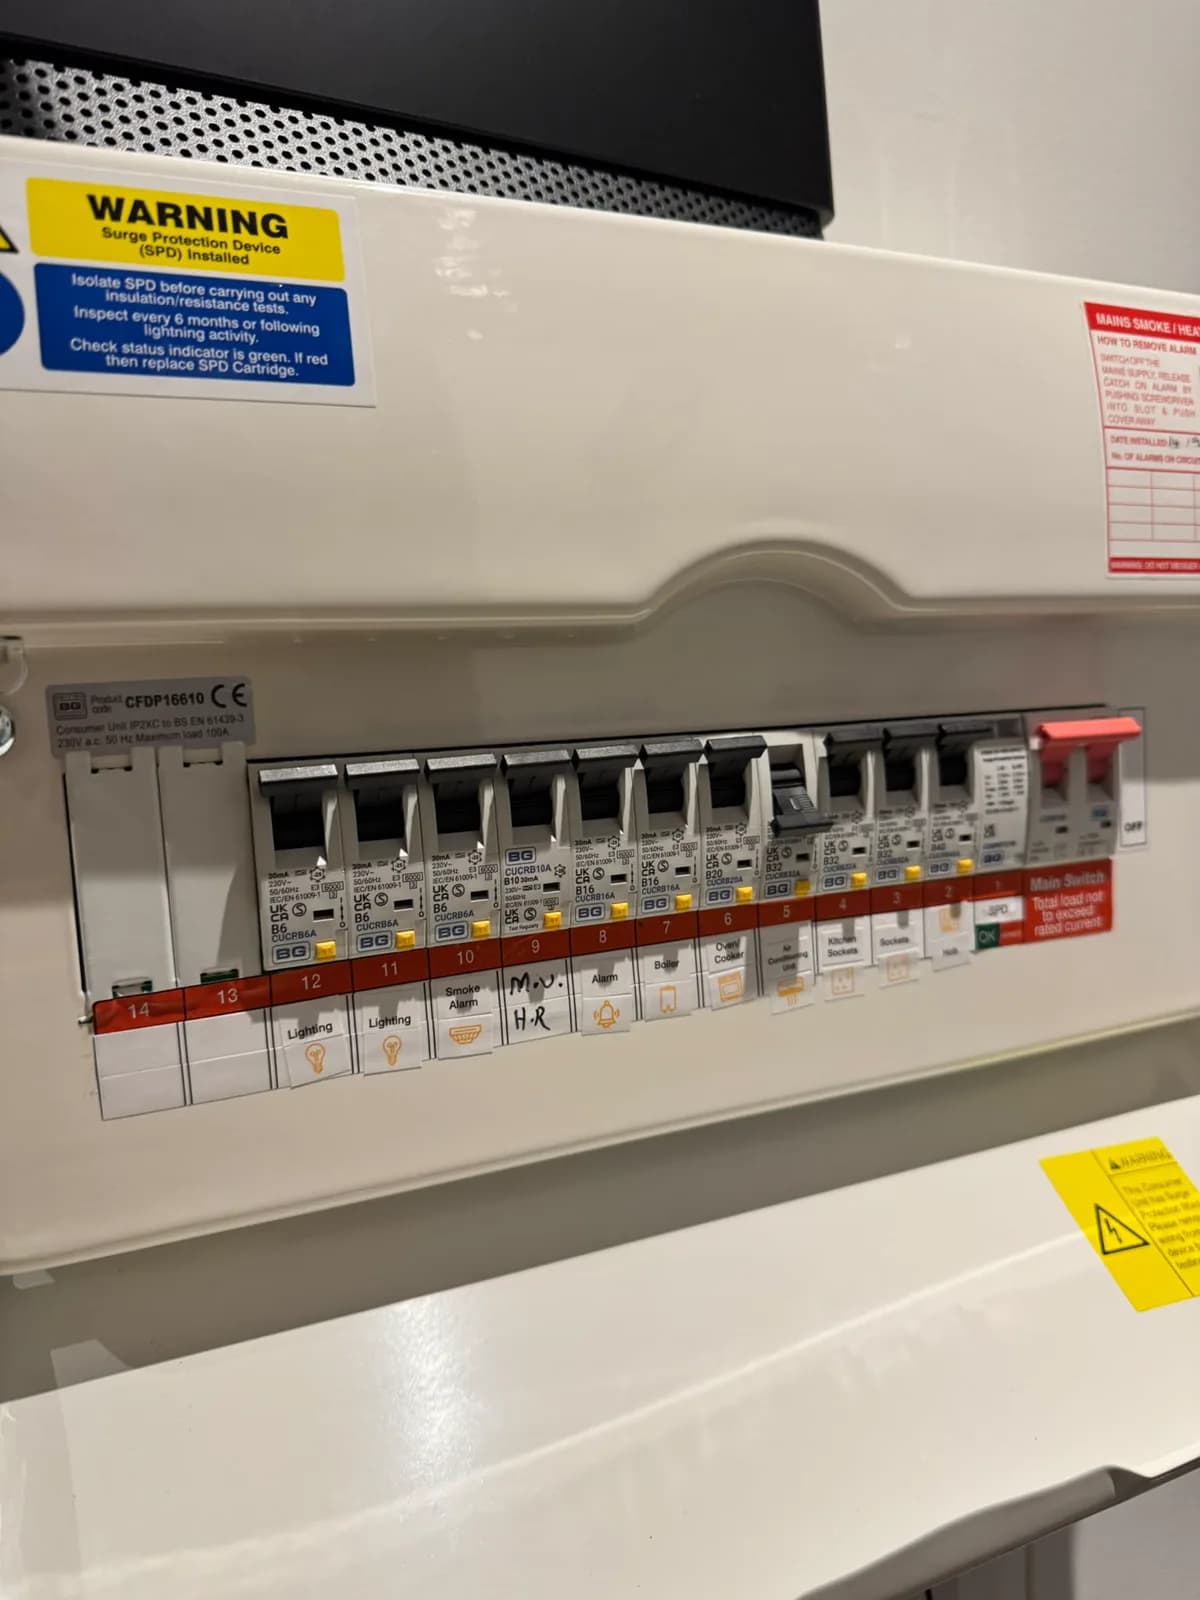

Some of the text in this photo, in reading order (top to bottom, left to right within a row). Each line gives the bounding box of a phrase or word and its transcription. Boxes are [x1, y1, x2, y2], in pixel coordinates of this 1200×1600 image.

[86, 193, 288, 239] WARNING
[101, 226, 281, 255] Surge Protection Device
[139, 243, 250, 266] (SPD) Installed
[71, 272, 317, 308] Isolate SPD before carrying out any
[105, 289, 289, 316] insulation/resistance tests.
[73, 304, 321, 337] Inspect every 6 months or following
[1095, 312, 1132, 329] MAINS
[1132, 317, 1170, 334] SMOKE
[143, 323, 259, 346] lightning activity.
[1097, 335, 1198, 355] HOW TO REMOVE ALARM
[70, 337, 329, 367] Check status indicator is green. If red
[105, 354, 299, 380] then replace SPD Cartridge.
[125, 691, 205, 709] CFDP16610
[211, 682, 248, 709] CE
[56, 723, 105, 737] Consumer
[174, 716, 188, 728] BS
[190, 715, 205, 727] EN
[105, 734, 118, 745] 50
[120, 734, 133, 745] Hz
[1123, 820, 1143, 832] OFF
[508, 850, 534, 862] BG
[824, 856, 840, 865] B32
[505, 864, 552, 877] CUCRB10A
[766, 862, 782, 873] B32
[930, 862, 949, 874] BG
[504, 875, 520, 885] B10
[706, 869, 723, 880] B20
[878, 869, 897, 881] BG
[1030, 869, 1106, 893] Main Switch
[641, 878, 660, 888] B16
[824, 875, 845, 888] BG
[432, 884, 448, 893] UK
[576, 884, 595, 896] B16
[641, 884, 681, 896] CUCRB16A
[767, 883, 788, 896] BG
[945, 884, 954, 898] 2
[353, 893, 371, 903] UK
[433, 893, 449, 902] CA
[576, 892, 616, 903] CUCRB16A
[709, 890, 730, 902] BG
[893, 892, 901, 905] 3
[1032, 889, 1105, 912] Total load not
[270, 903, 288, 913] UK
[354, 902, 372, 911] CA
[433, 903, 448, 914] B6
[644, 898, 667, 911] BG
[838, 898, 848, 911] 4
[270, 912, 289, 922] CA
[354, 912, 370, 923] B6
[434, 910, 474, 922] CUCRB6A
[578, 906, 602, 918] BG
[783, 905, 792, 918] 5
[1042, 904, 1094, 923] to exceed
[356, 919, 399, 931] CUCRB6A
[724, 911, 733, 926] 6
[271, 923, 287, 935] B6
[438, 924, 465, 939] BG
[663, 920, 672, 935] 7
[1033, 921, 1062, 937] rated
[271, 929, 317, 942] CUCRB6A
[360, 934, 388, 948] BG
[599, 929, 608, 944] 8
[828, 935, 857, 946] Kitchen
[880, 935, 910, 947] Sockets
[978, 930, 997, 943] OK
[531, 939, 541, 954] 9
[715, 938, 740, 952] Oven/
[276, 945, 306, 960] BG
[456, 950, 475, 966] 10
[714, 950, 745, 965] Cooker
[827, 947, 859, 958] Sockets
[381, 961, 400, 977] 11
[653, 959, 680, 970] Boiler
[782, 962, 797, 972] Unit
[301, 973, 323, 991] 12
[591, 971, 619, 985] Alarm
[445, 983, 482, 997] Smoke
[217, 989, 239, 1005] 13
[448, 997, 479, 1010] Alarm
[128, 1002, 150, 1020] 14
[368, 1013, 412, 1030] Lighting
[287, 1021, 335, 1040] Lighting
